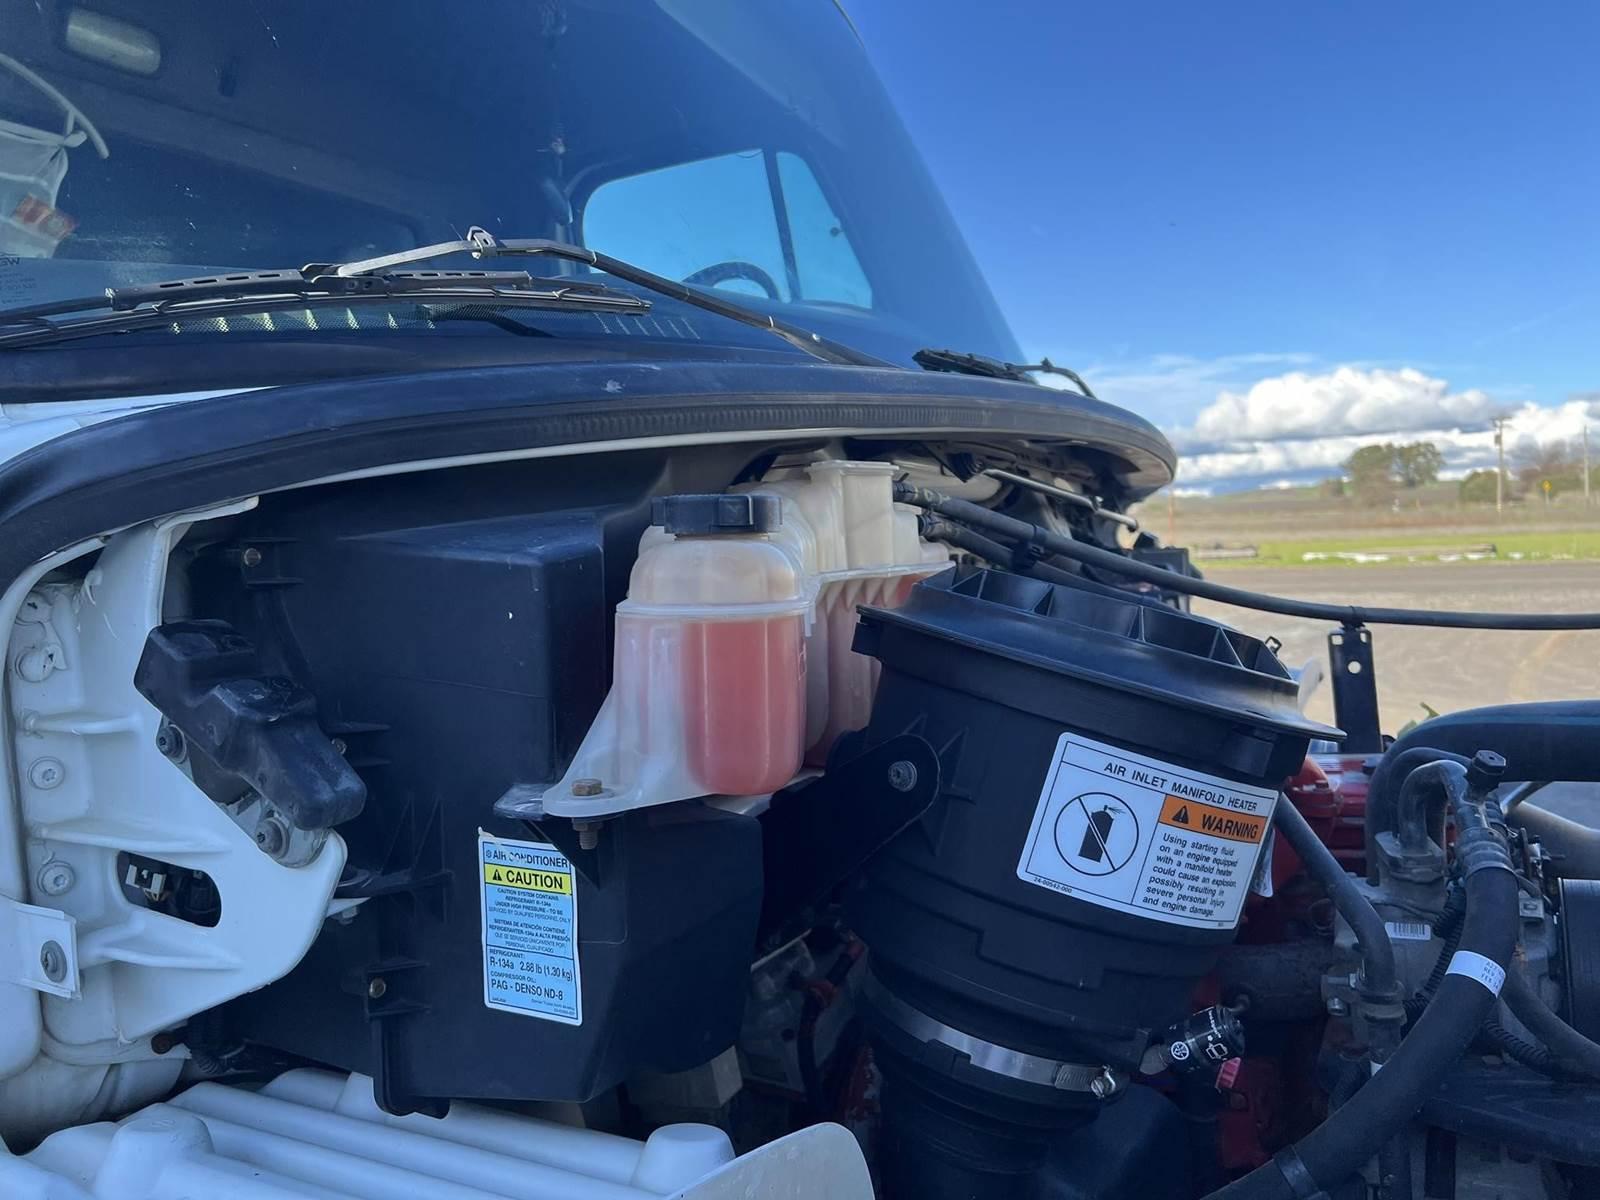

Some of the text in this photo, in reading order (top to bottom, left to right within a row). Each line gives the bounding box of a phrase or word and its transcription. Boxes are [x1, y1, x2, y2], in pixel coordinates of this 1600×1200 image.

[1104, 762, 1258, 812] AIR INLET MANIFOLD HEATER
[1201, 813, 1259, 839] WARNING
[1163, 832, 1235, 857] Using starting fluid
[1156, 855, 1174, 865] with
[1184, 862, 1215, 874] manifold
[1215, 867, 1233, 877] heater
[1159, 844, 1238, 868] on an engine equipped
[506, 870, 563, 889] CAUTION
[1153, 865, 1176, 877] could
[1178, 871, 1200, 883] cause
[1201, 876, 1210, 884] an
[1146, 886, 1174, 898] severe
[1176, 893, 1208, 905] personal
[1148, 875, 1185, 891] possibly
[1187, 884, 1217, 897] resulting
[1142, 895, 1159, 905] and
[1161, 900, 1187, 912] engine
[490, 956, 573, 983] R-134a 2.88 lb (1.30 kg)
[490, 971, 526, 981] COMPRESSOR
[491, 979, 508, 990] PAG
[515, 982, 542, 996] DENSO
[544, 988, 563, 1001] ND-8
